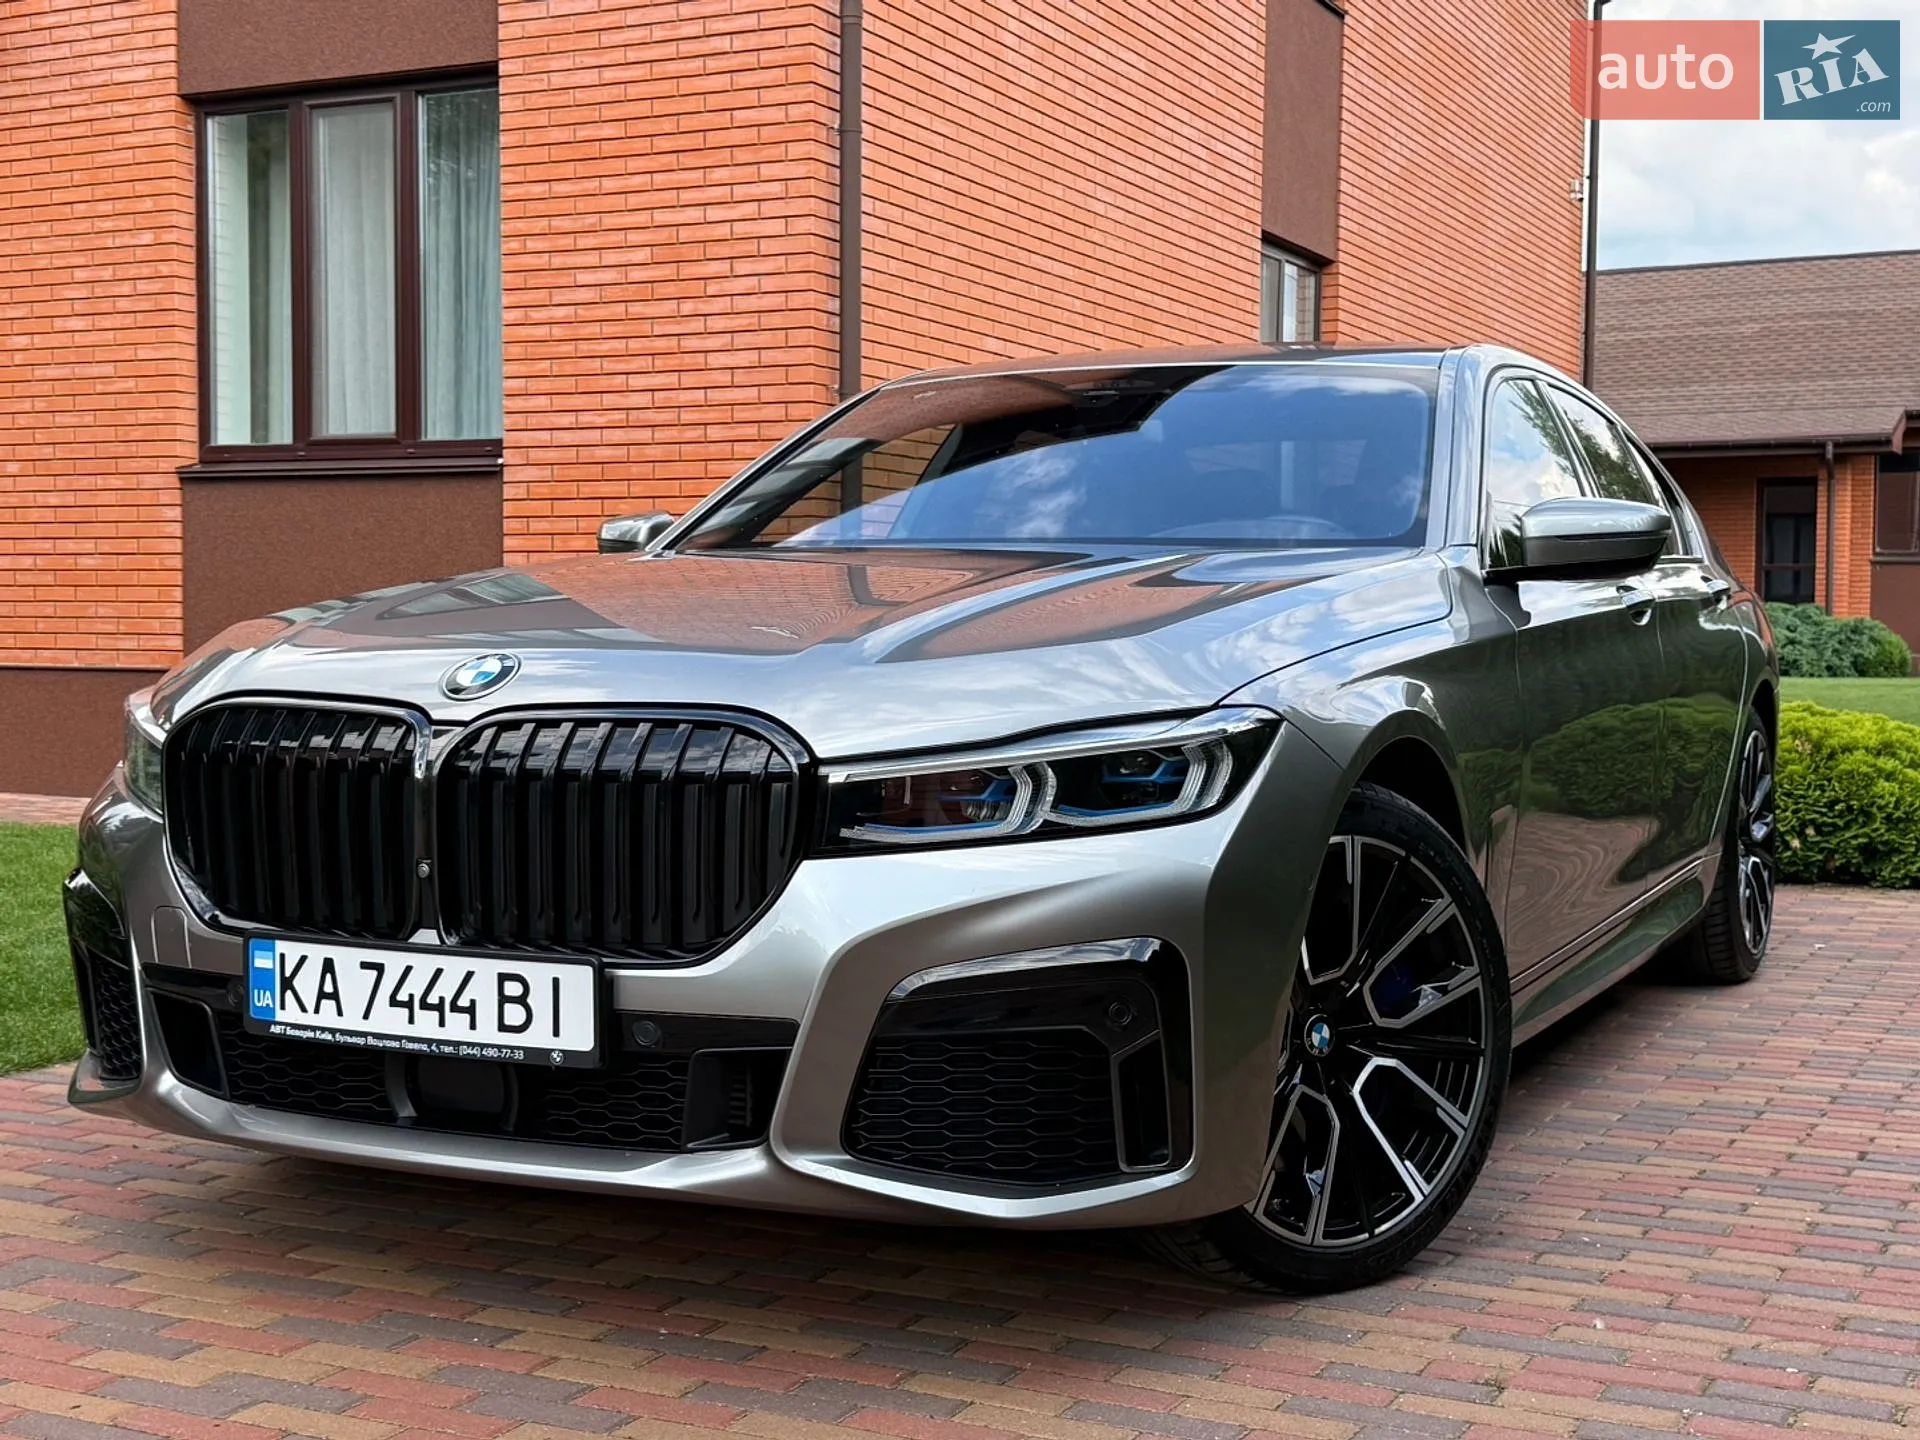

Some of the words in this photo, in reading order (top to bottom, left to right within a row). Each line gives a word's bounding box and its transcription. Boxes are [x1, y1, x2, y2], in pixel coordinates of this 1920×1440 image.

[254, 989, 273, 1008] UA
[279, 952, 343, 1017] KA
[359, 960, 477, 1031] 7444
